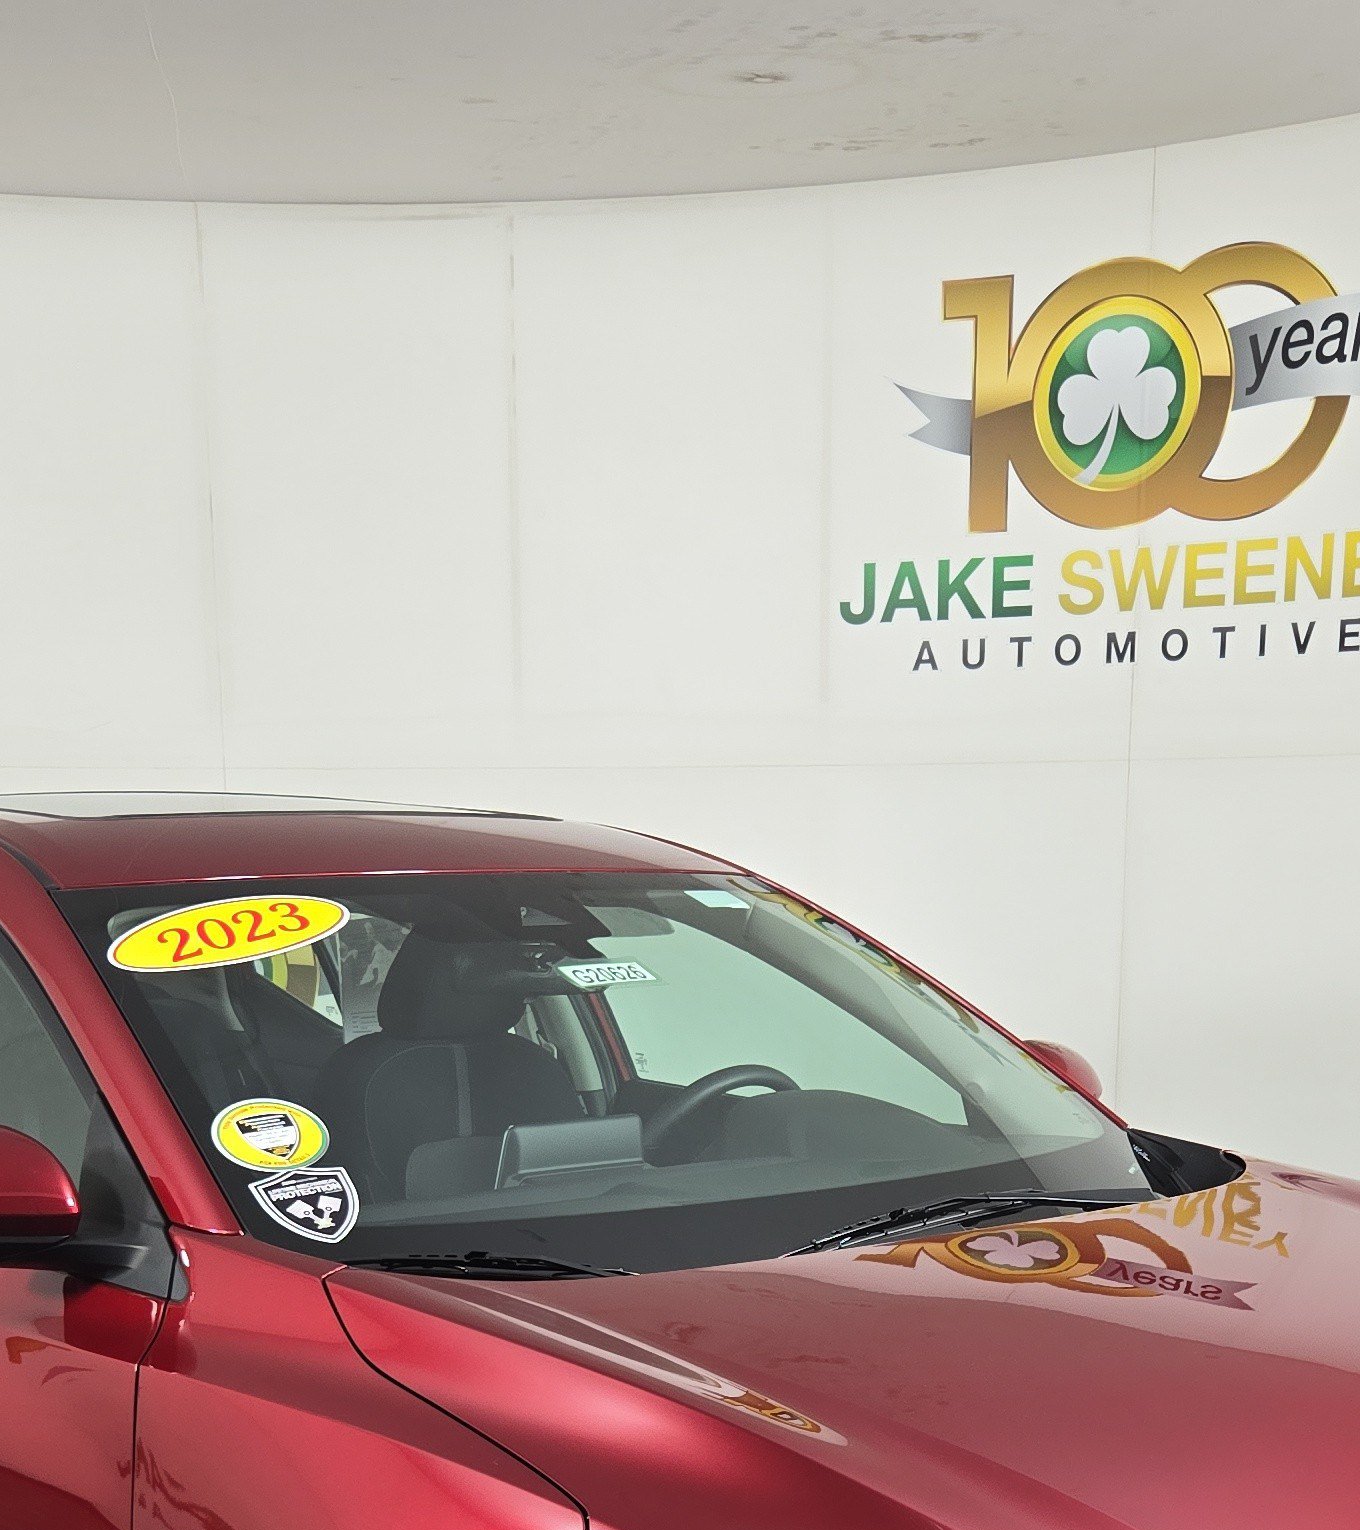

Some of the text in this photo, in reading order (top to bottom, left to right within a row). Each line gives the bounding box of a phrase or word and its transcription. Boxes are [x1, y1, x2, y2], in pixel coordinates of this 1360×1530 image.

[941, 240, 1352, 533] 100
[840, 554, 1035, 625] JAKE
[157, 902, 311, 963] 2023
[571, 964, 648, 984] G20626
